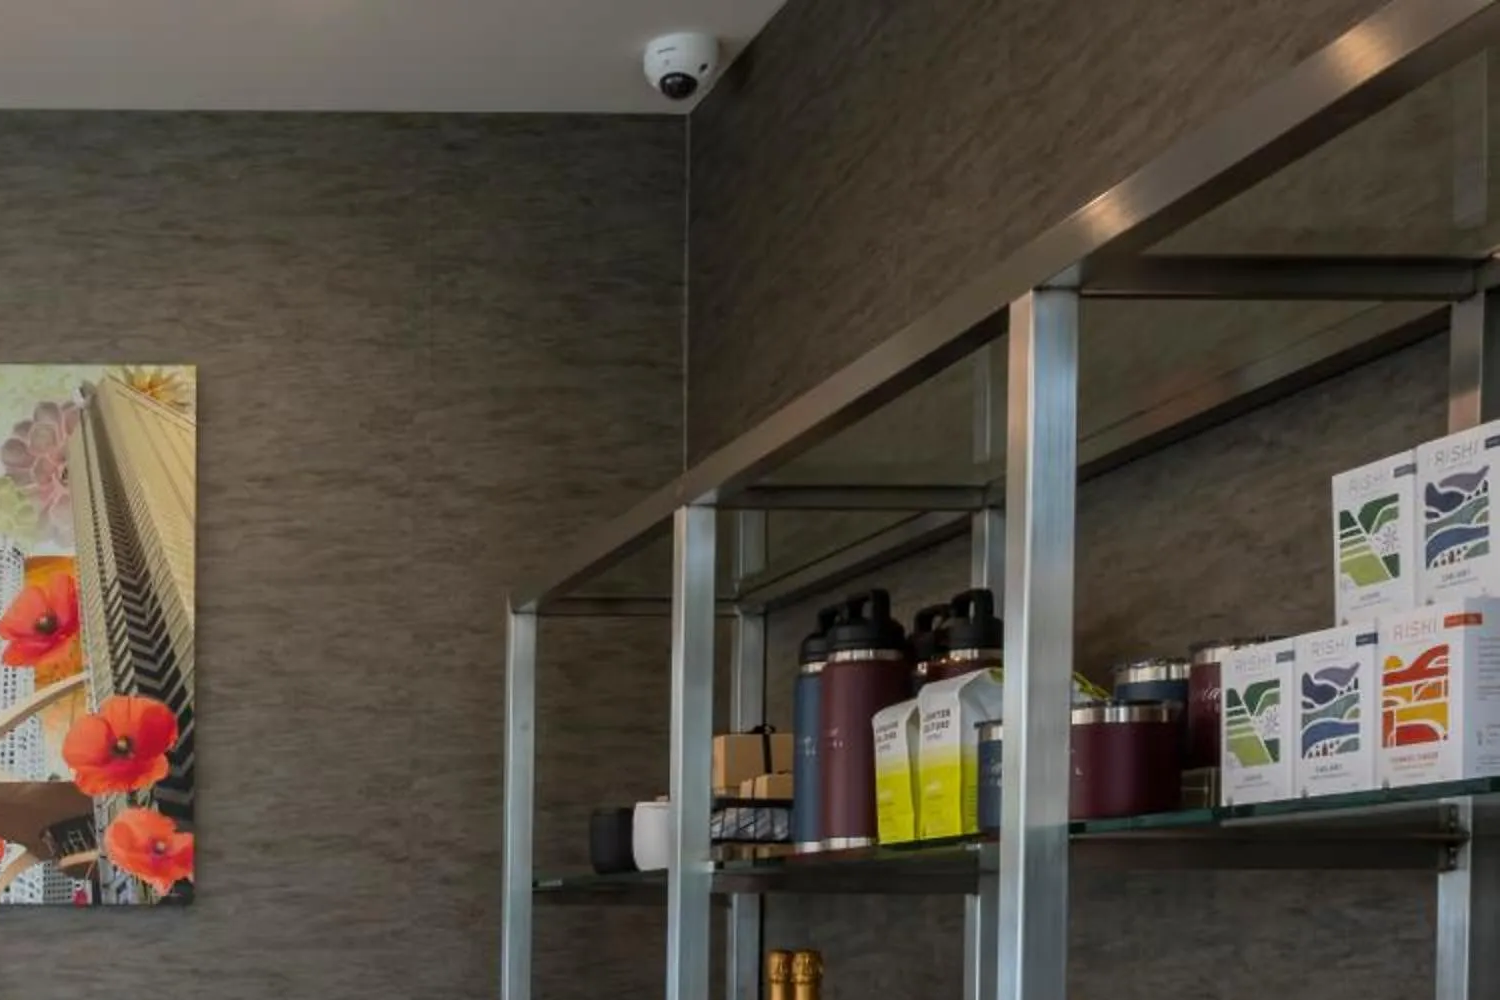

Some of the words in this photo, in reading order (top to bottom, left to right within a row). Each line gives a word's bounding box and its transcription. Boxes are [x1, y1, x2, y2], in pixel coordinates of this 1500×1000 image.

[1435, 439, 1479, 466] RISHI
[1392, 617, 1438, 641] RISHI
[1311, 636, 1349, 657] RISHI
